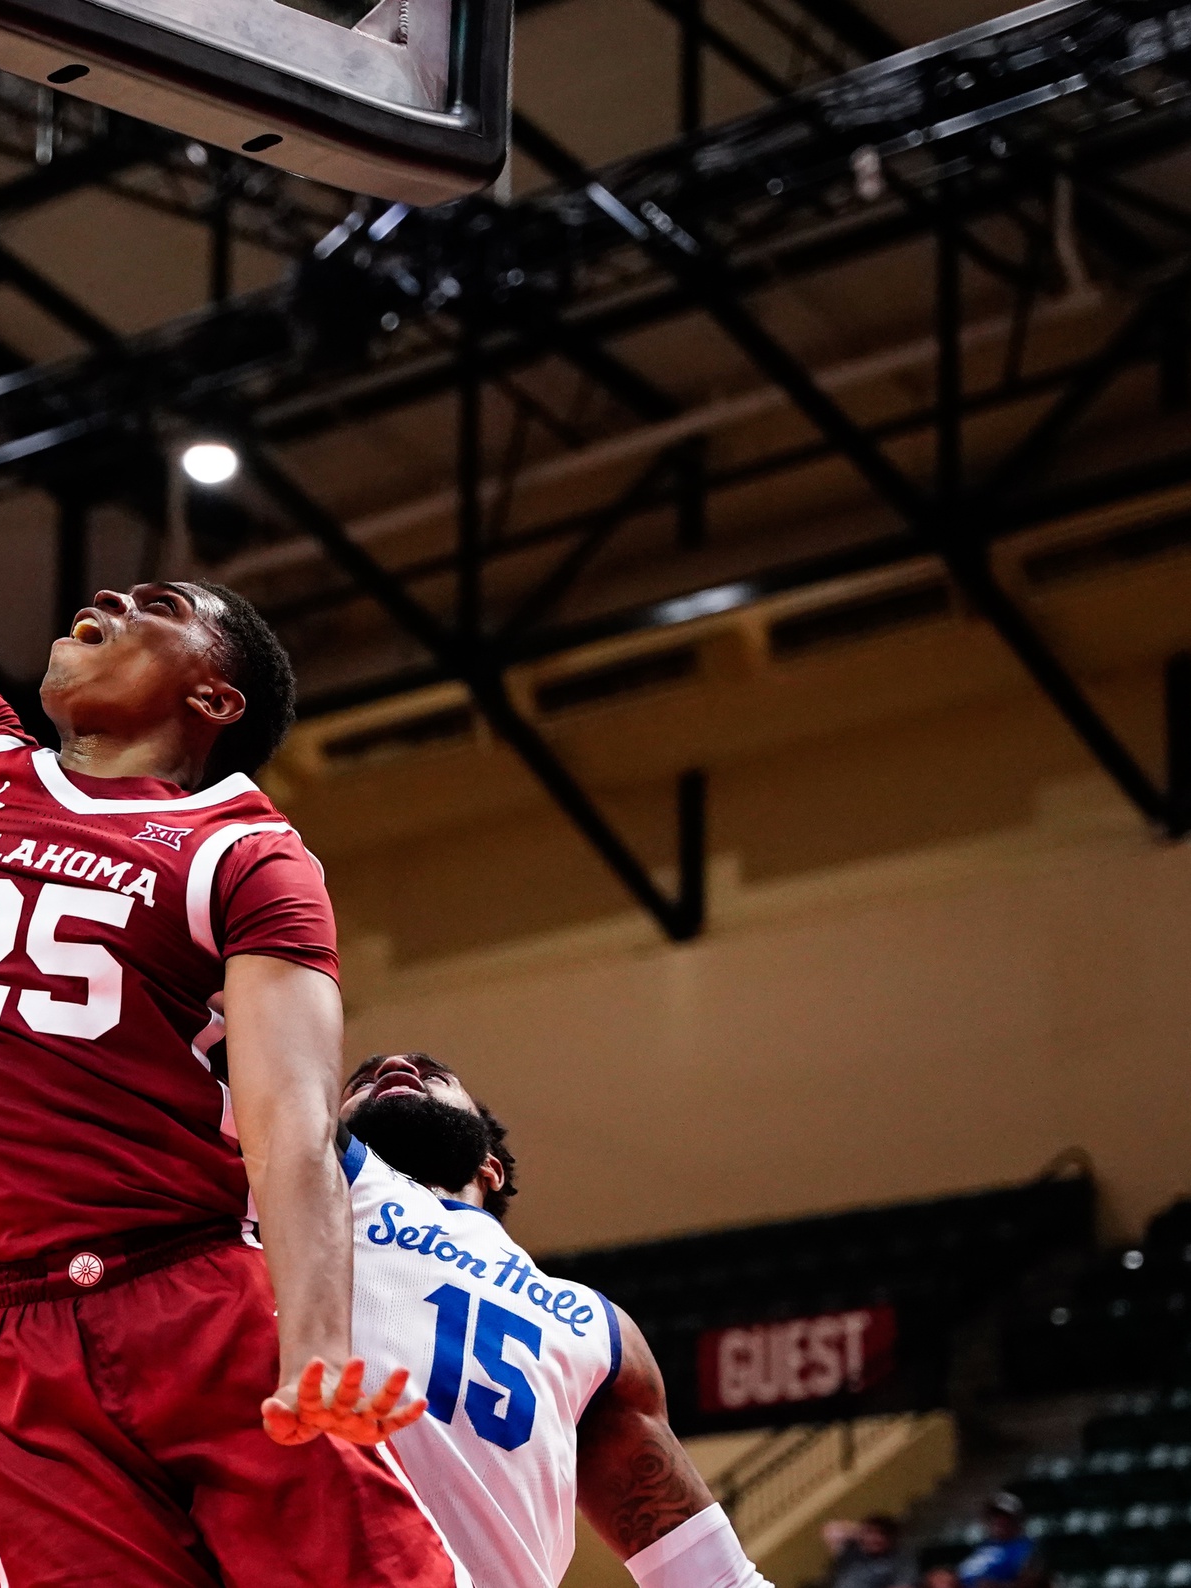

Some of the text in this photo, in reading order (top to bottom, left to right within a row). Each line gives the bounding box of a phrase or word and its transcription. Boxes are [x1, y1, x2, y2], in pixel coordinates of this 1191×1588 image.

[367, 1201, 594, 1337] Seton Hall
[423, 1282, 543, 1452] 15
[718, 1310, 872, 1409] GUEST
